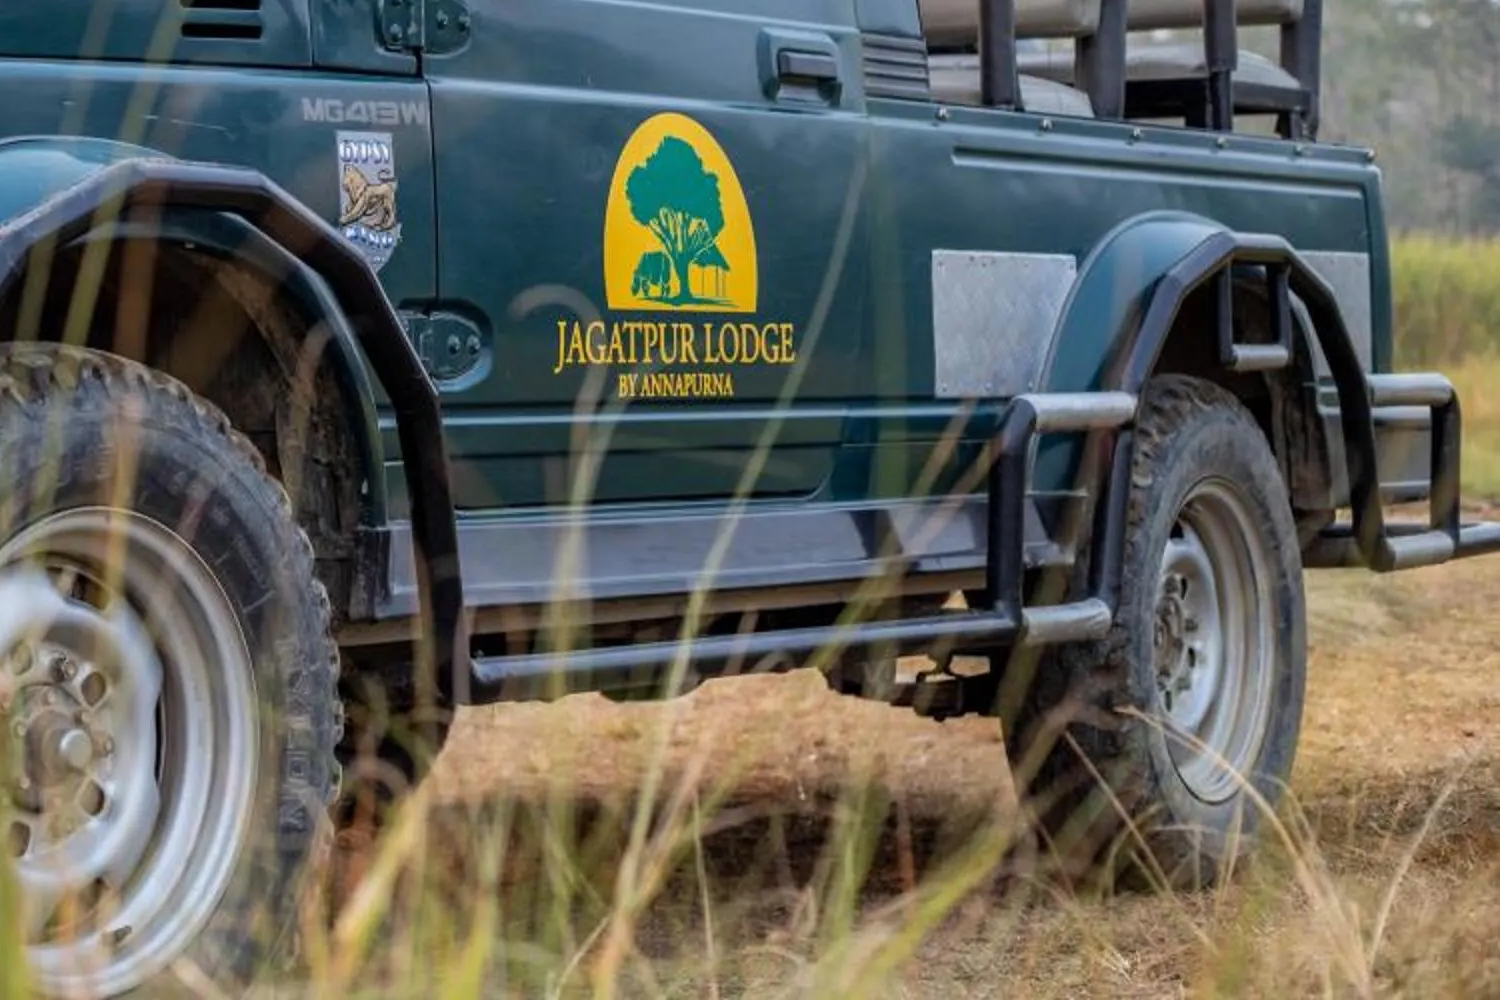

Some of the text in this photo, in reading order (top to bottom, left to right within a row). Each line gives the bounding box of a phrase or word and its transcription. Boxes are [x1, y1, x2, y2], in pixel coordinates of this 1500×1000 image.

[338, 139, 390, 165] GYPSY
[553, 320, 797, 375] JAGATPUR LODGE
[618, 372, 735, 397] BY ANNAPURNA
